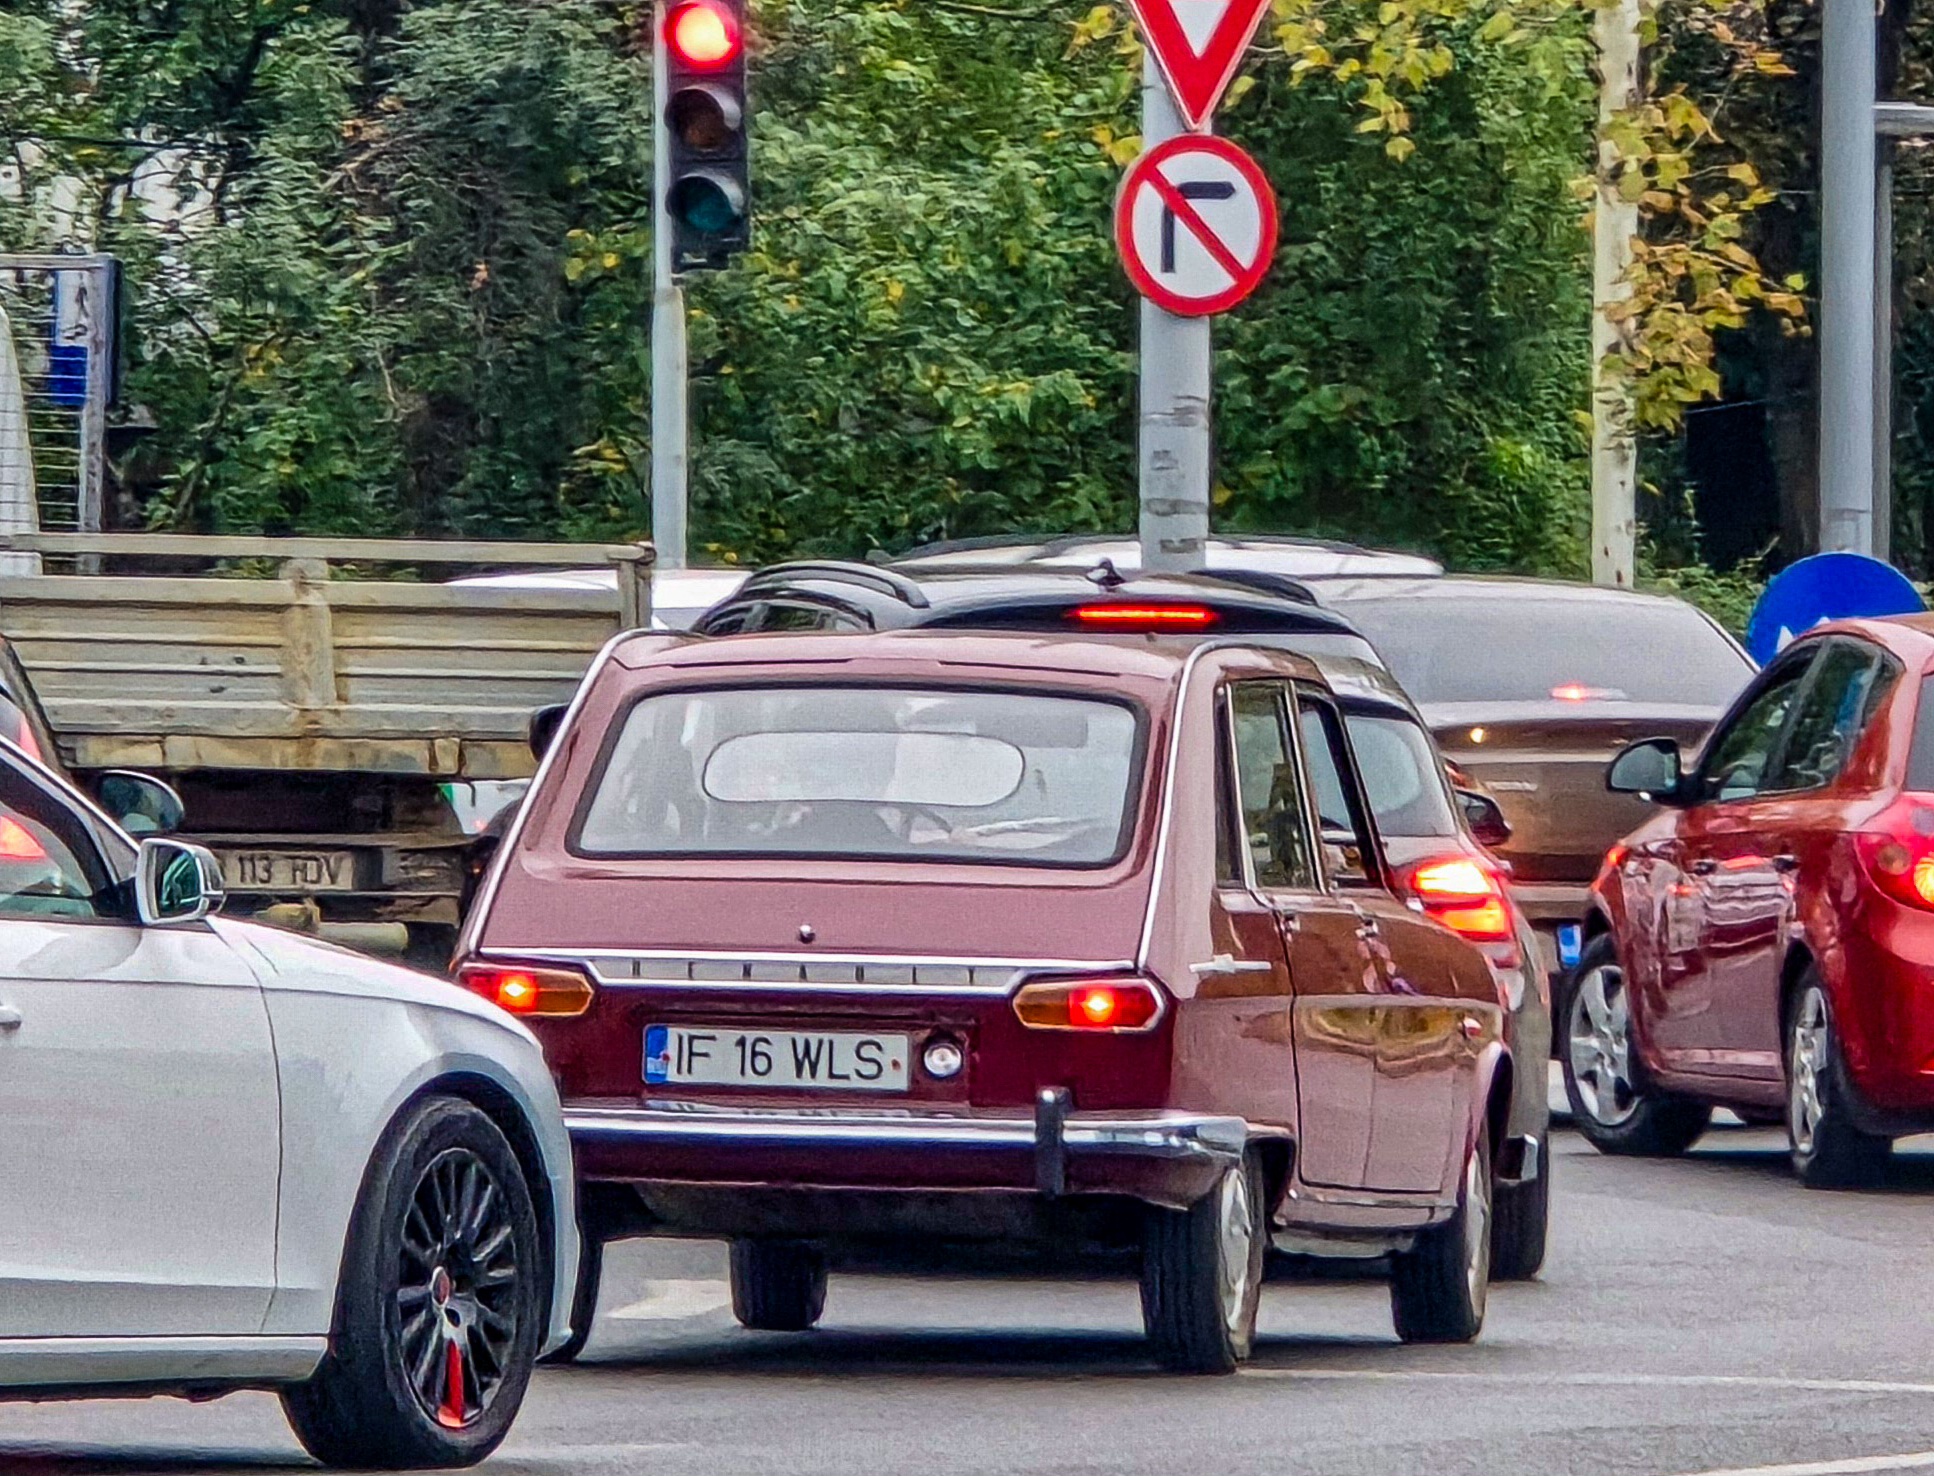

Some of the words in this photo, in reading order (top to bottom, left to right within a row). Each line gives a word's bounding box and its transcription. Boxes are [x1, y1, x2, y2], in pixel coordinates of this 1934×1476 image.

[676, 1033, 717, 1074] IF
[734, 1035, 773, 1077] 16
[791, 1037, 884, 1080] WLS
